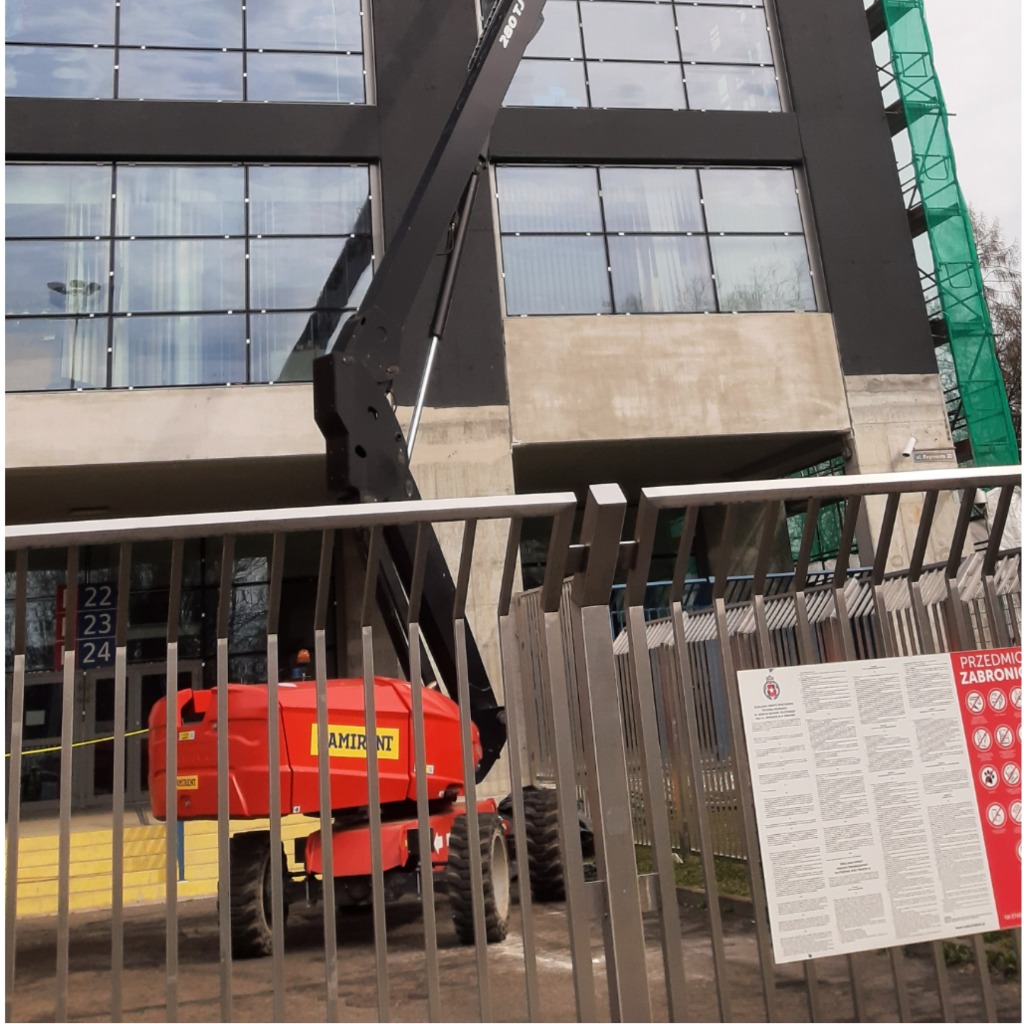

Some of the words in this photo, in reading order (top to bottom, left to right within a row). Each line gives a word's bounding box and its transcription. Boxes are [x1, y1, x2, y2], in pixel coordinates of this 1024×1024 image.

[85, 586, 112, 607] 22
[84, 613, 111, 635] 23
[83, 641, 111, 663] 24
[320, 732, 394, 752] AMIRNT
